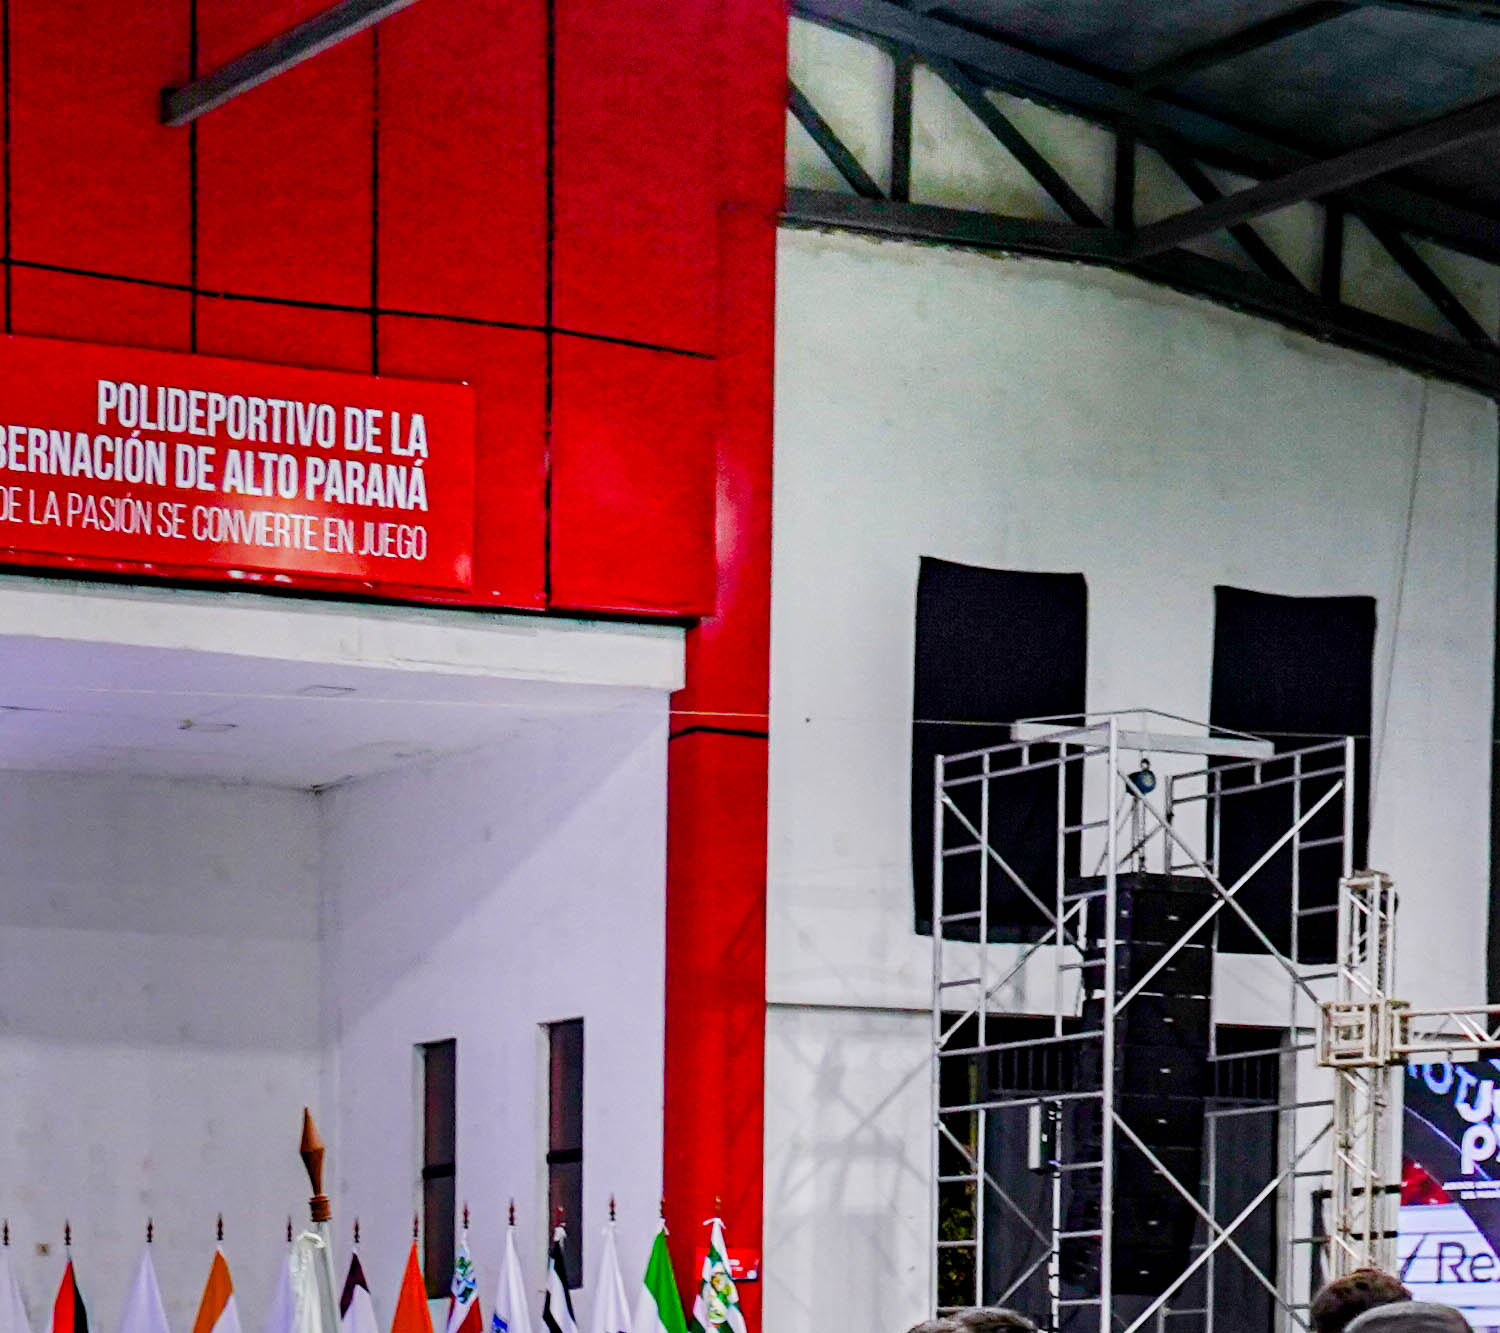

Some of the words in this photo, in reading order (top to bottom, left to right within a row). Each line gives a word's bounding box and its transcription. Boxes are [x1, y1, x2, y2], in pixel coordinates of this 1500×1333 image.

[98, 380, 336, 449] POLIDEPORTIVO
[345, 407, 383, 453] DE
[391, 411, 428, 458] LA
[175, 444, 215, 491] DE
[222, 449, 299, 499] ALTO
[306, 455, 429, 511] PARANÁ
[28, 488, 62, 525] LA
[66, 491, 153, 536] PASIÓN
[157, 502, 187, 539] SE
[192, 506, 319, 553] CONVIERTE
[323, 517, 355, 556] EN
[358, 520, 428, 560] JUEGO
